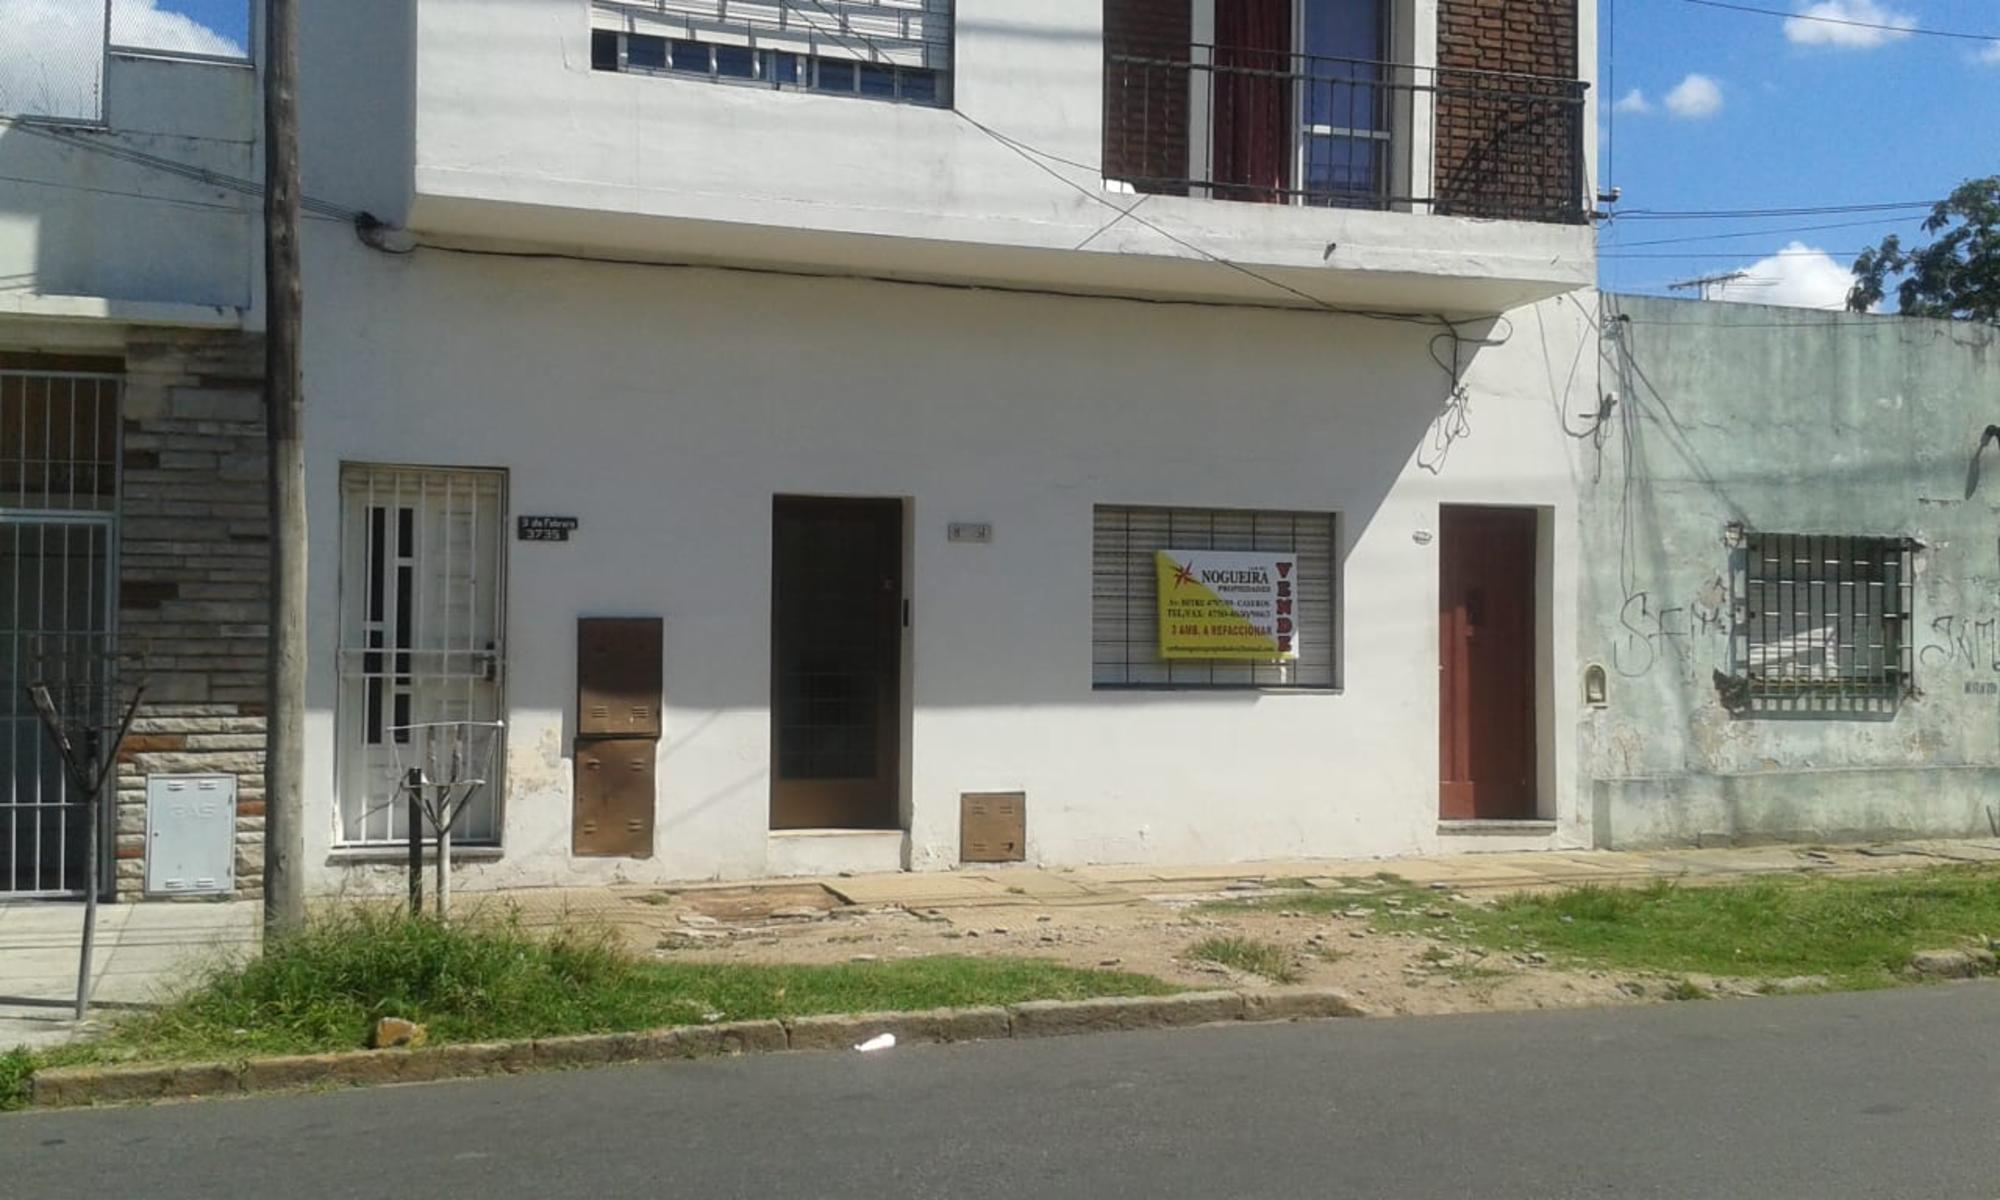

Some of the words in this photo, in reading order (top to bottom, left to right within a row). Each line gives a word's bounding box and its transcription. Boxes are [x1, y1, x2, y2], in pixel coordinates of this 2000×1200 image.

[1202, 570, 1269, 584] NOGUEIRA
[1218, 585, 1271, 593] PROPIEDADES
[1276, 562, 1293, 652] VENDE
[1210, 624, 1273, 637] REFACCIONAR
